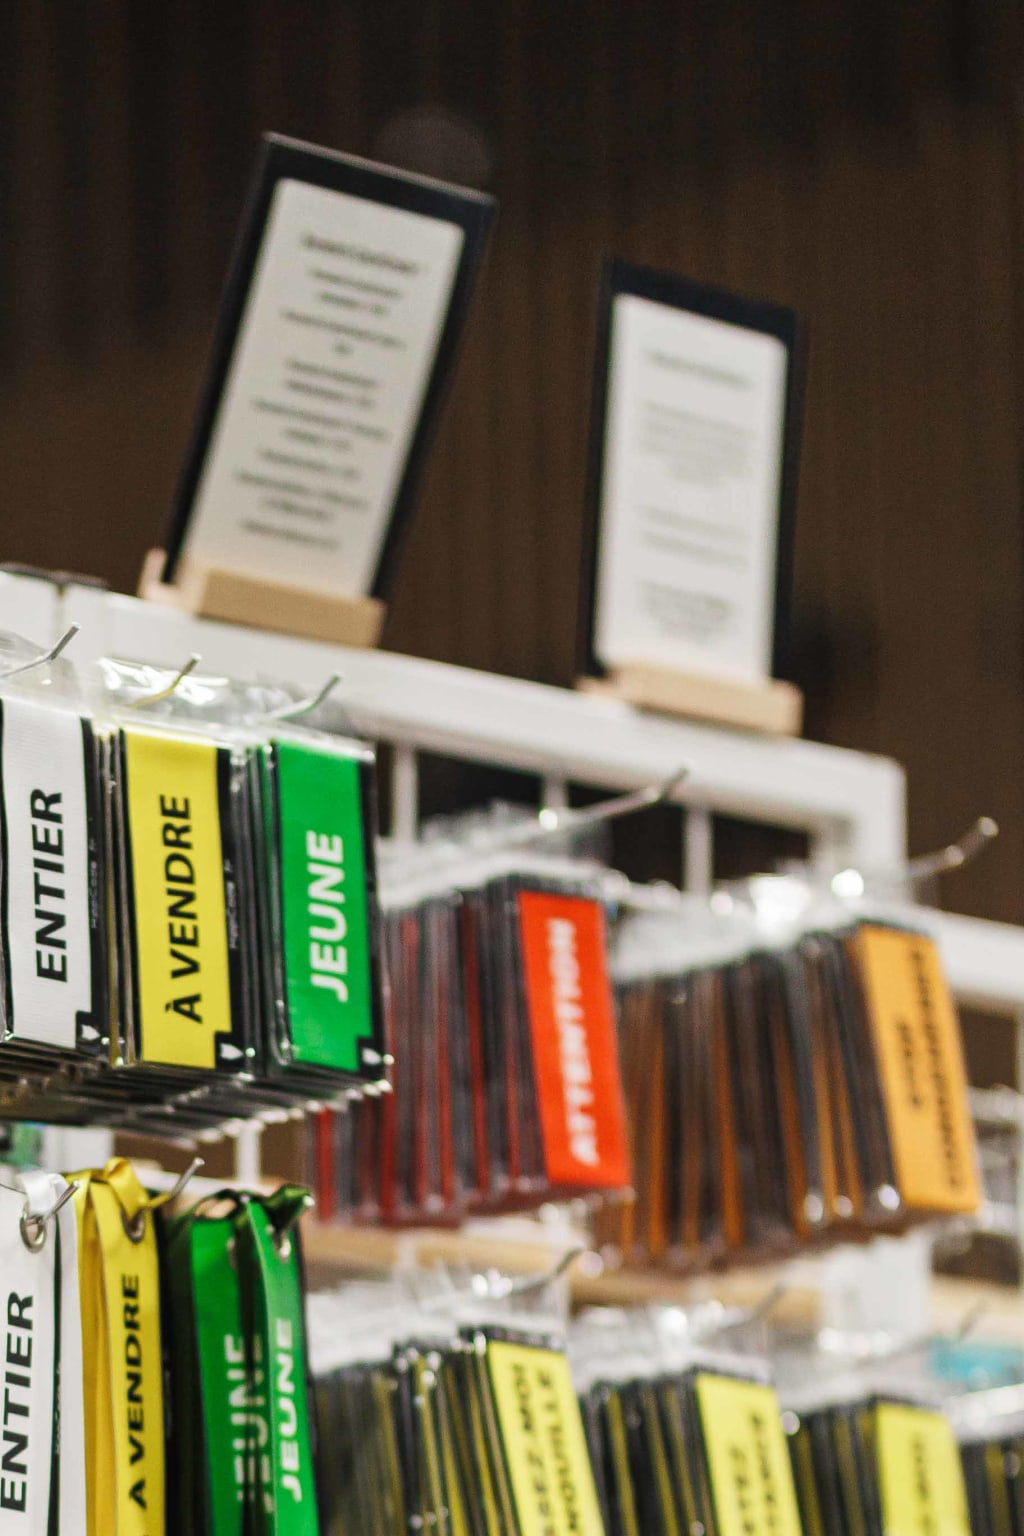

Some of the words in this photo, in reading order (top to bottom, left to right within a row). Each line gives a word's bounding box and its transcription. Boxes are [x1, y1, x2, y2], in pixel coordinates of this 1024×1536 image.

[30, 788, 67, 983] ENTIER
[159, 795, 200, 979] VENDRE
[306, 830, 348, 1002] JEUNE
[165, 992, 203, 1024] À
[548, 918, 600, 1166] ATTENTION
[0, 1291, 34, 1513] ENTIER
[122, 1273, 145, 1466] VENDRE
[275, 1316, 304, 1503] JEUNE
[128, 1476, 148, 1510] A
